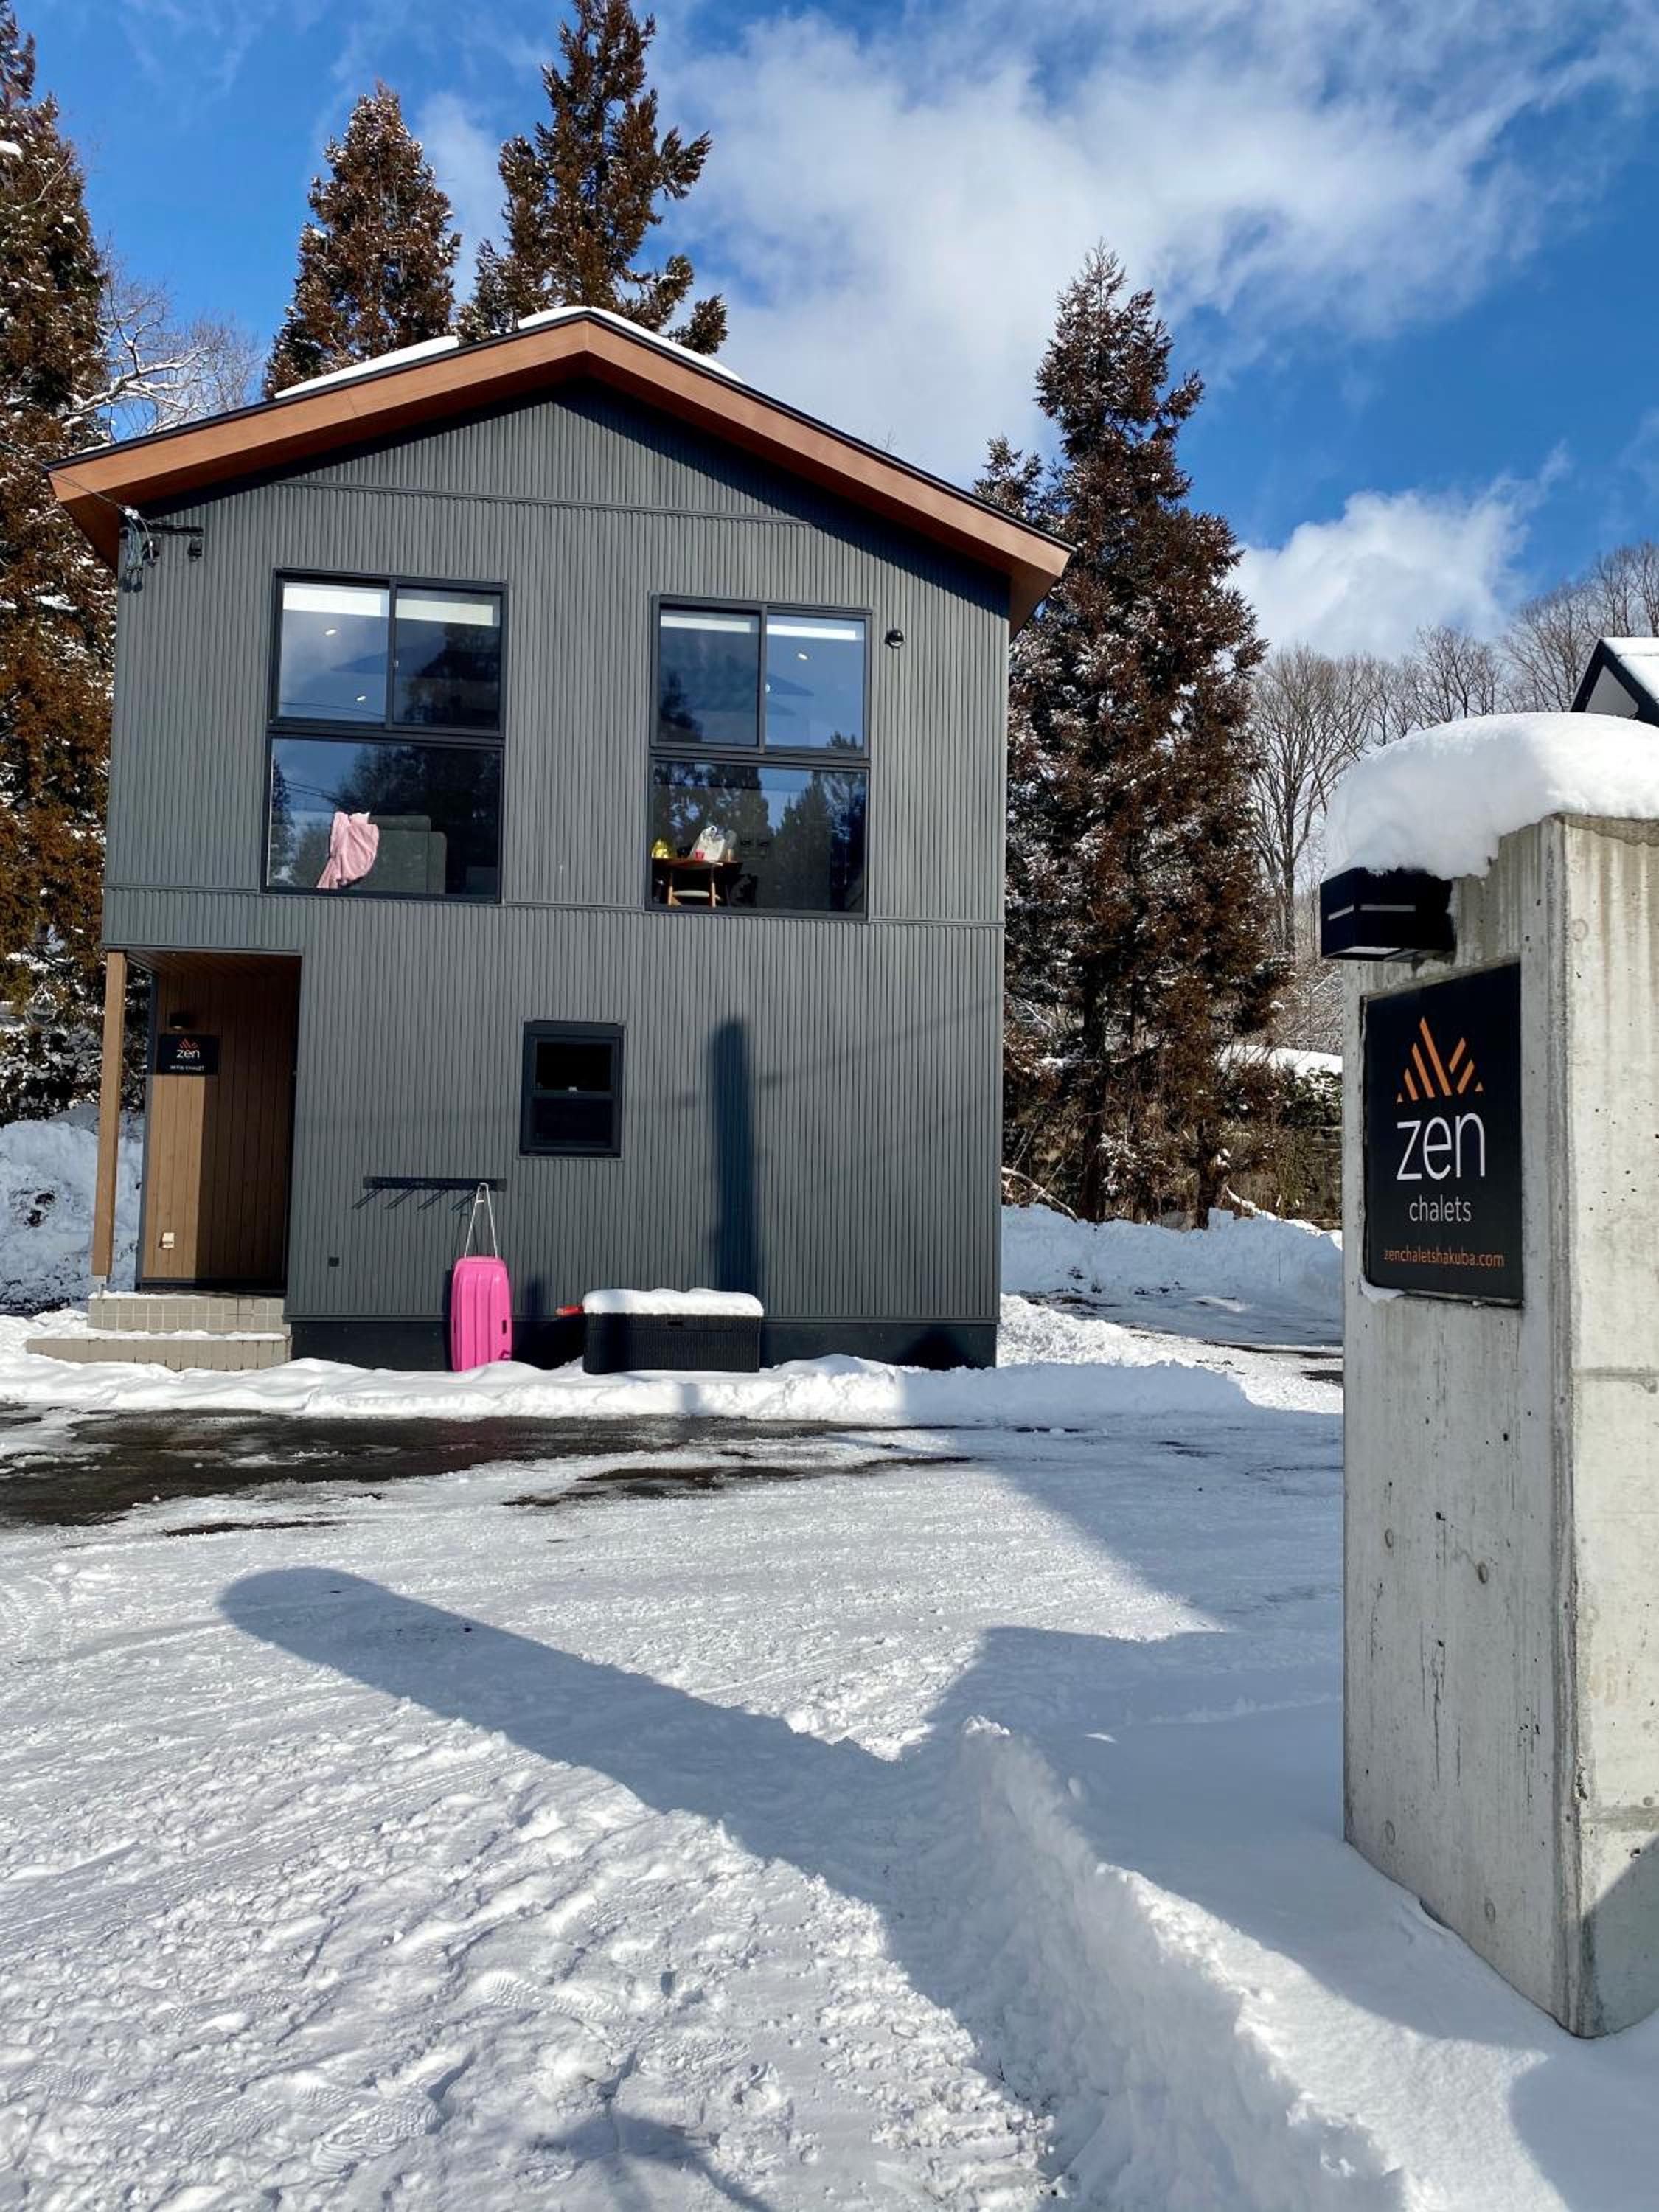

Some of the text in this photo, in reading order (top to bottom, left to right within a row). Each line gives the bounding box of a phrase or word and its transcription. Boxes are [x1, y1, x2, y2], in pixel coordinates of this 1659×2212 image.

[176, 1049, 200, 1059] zen
[1397, 1113, 1485, 1180] zen
[1409, 1195, 1472, 1222] chalets
[1384, 1245, 1505, 1267] zenchaletshakuba.com
